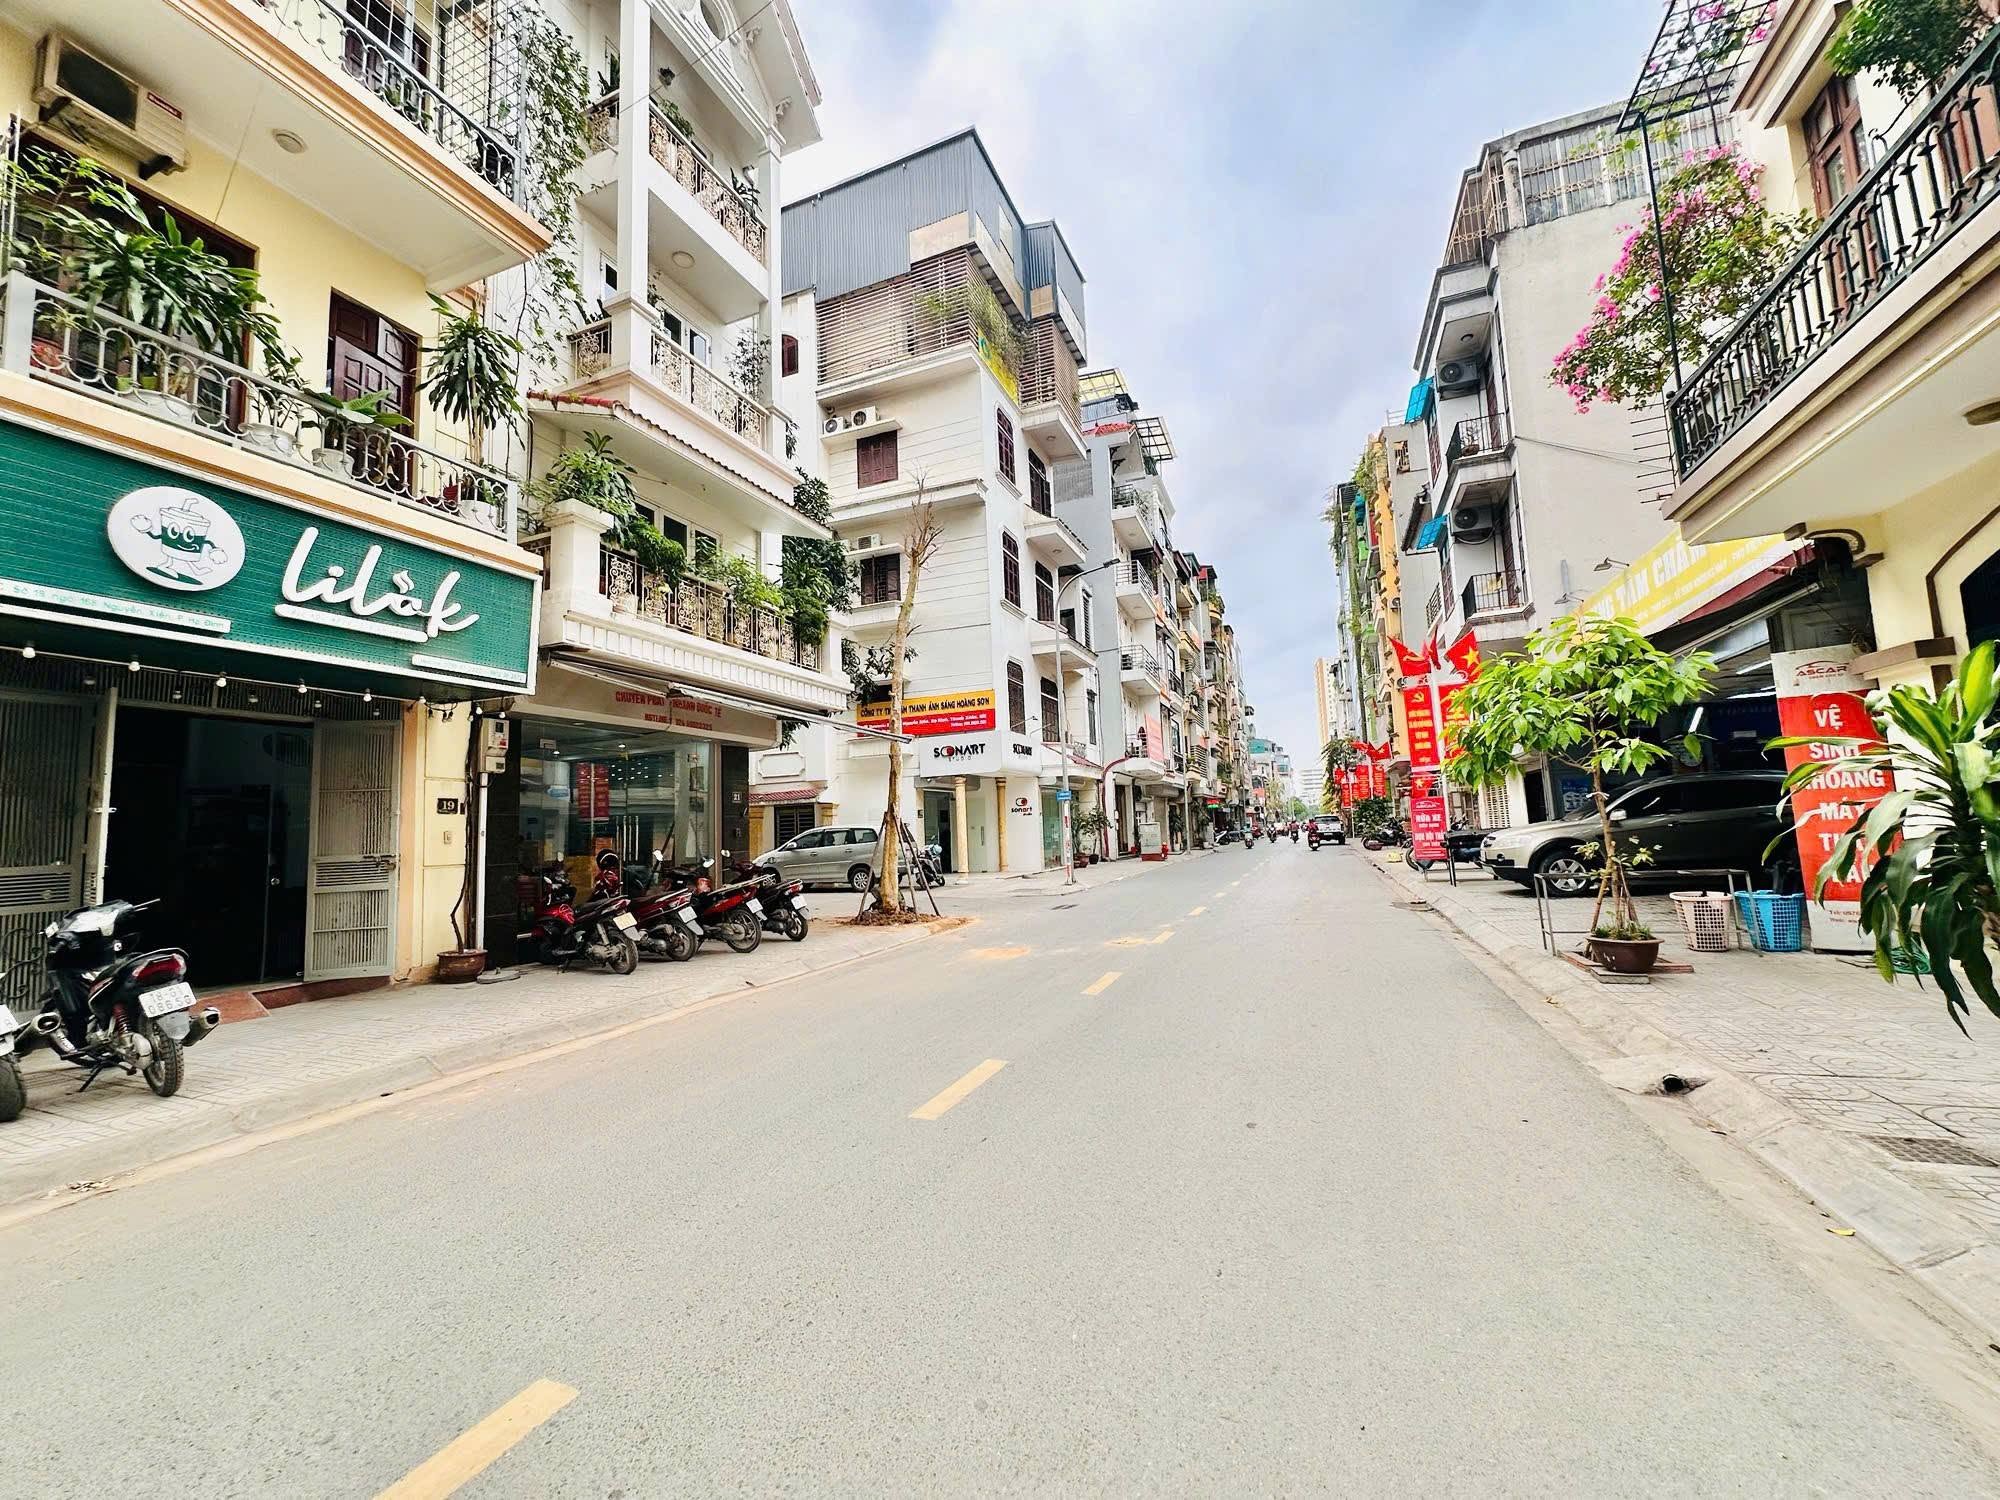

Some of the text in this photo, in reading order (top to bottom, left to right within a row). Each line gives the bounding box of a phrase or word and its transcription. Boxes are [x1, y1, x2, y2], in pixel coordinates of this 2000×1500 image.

[1797, 665, 1848, 677] ASCAR
[909, 703, 927, 713] THANH
[1813, 703, 1844, 731] VỆ
[933, 743, 986, 760] SONART
[1805, 768, 1885, 790] HOANG
[442, 800, 455, 811] 19
